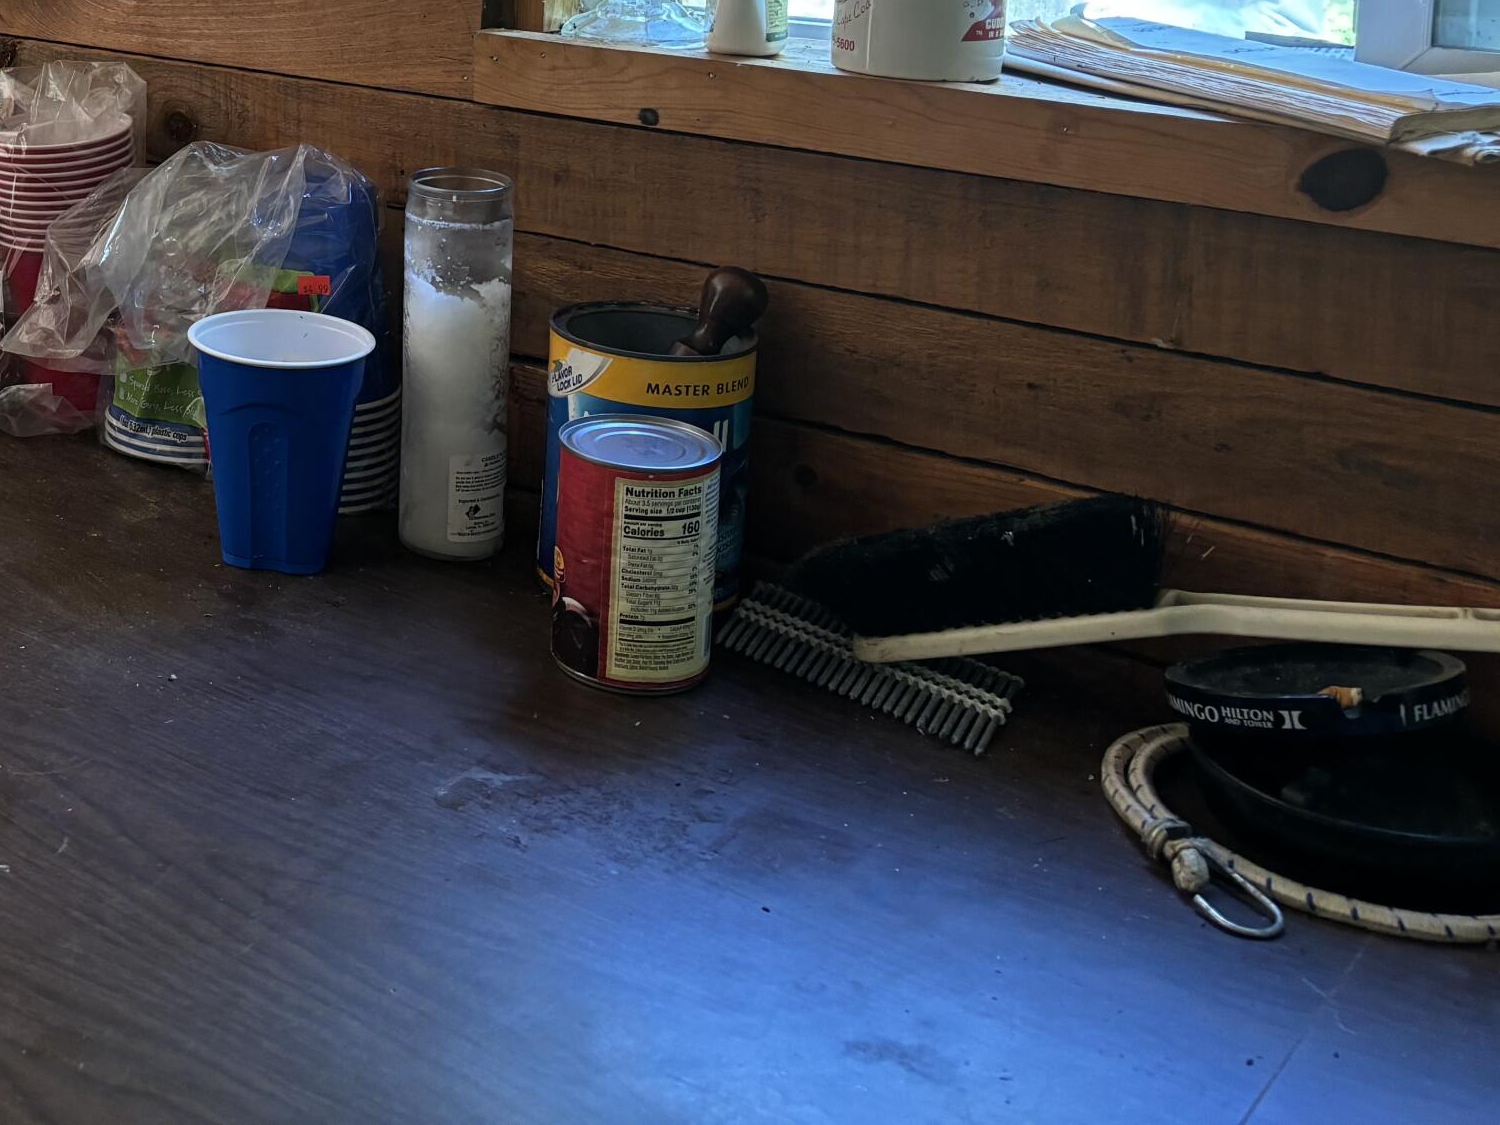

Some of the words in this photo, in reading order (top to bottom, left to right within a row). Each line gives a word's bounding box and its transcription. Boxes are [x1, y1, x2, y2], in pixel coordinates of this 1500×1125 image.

[572, 373, 583, 386] LID
[646, 382, 710, 397] MASTER
[716, 376, 749, 395] BLEND
[625, 486, 676, 498] Nutrition
[678, 485, 702, 497] Facts
[624, 505, 648, 515] Serving
[649, 507, 663, 515] size
[623, 526, 665, 537] Calories
[682, 520, 700, 535] 160
[1221, 705, 1275, 722] HILTON
